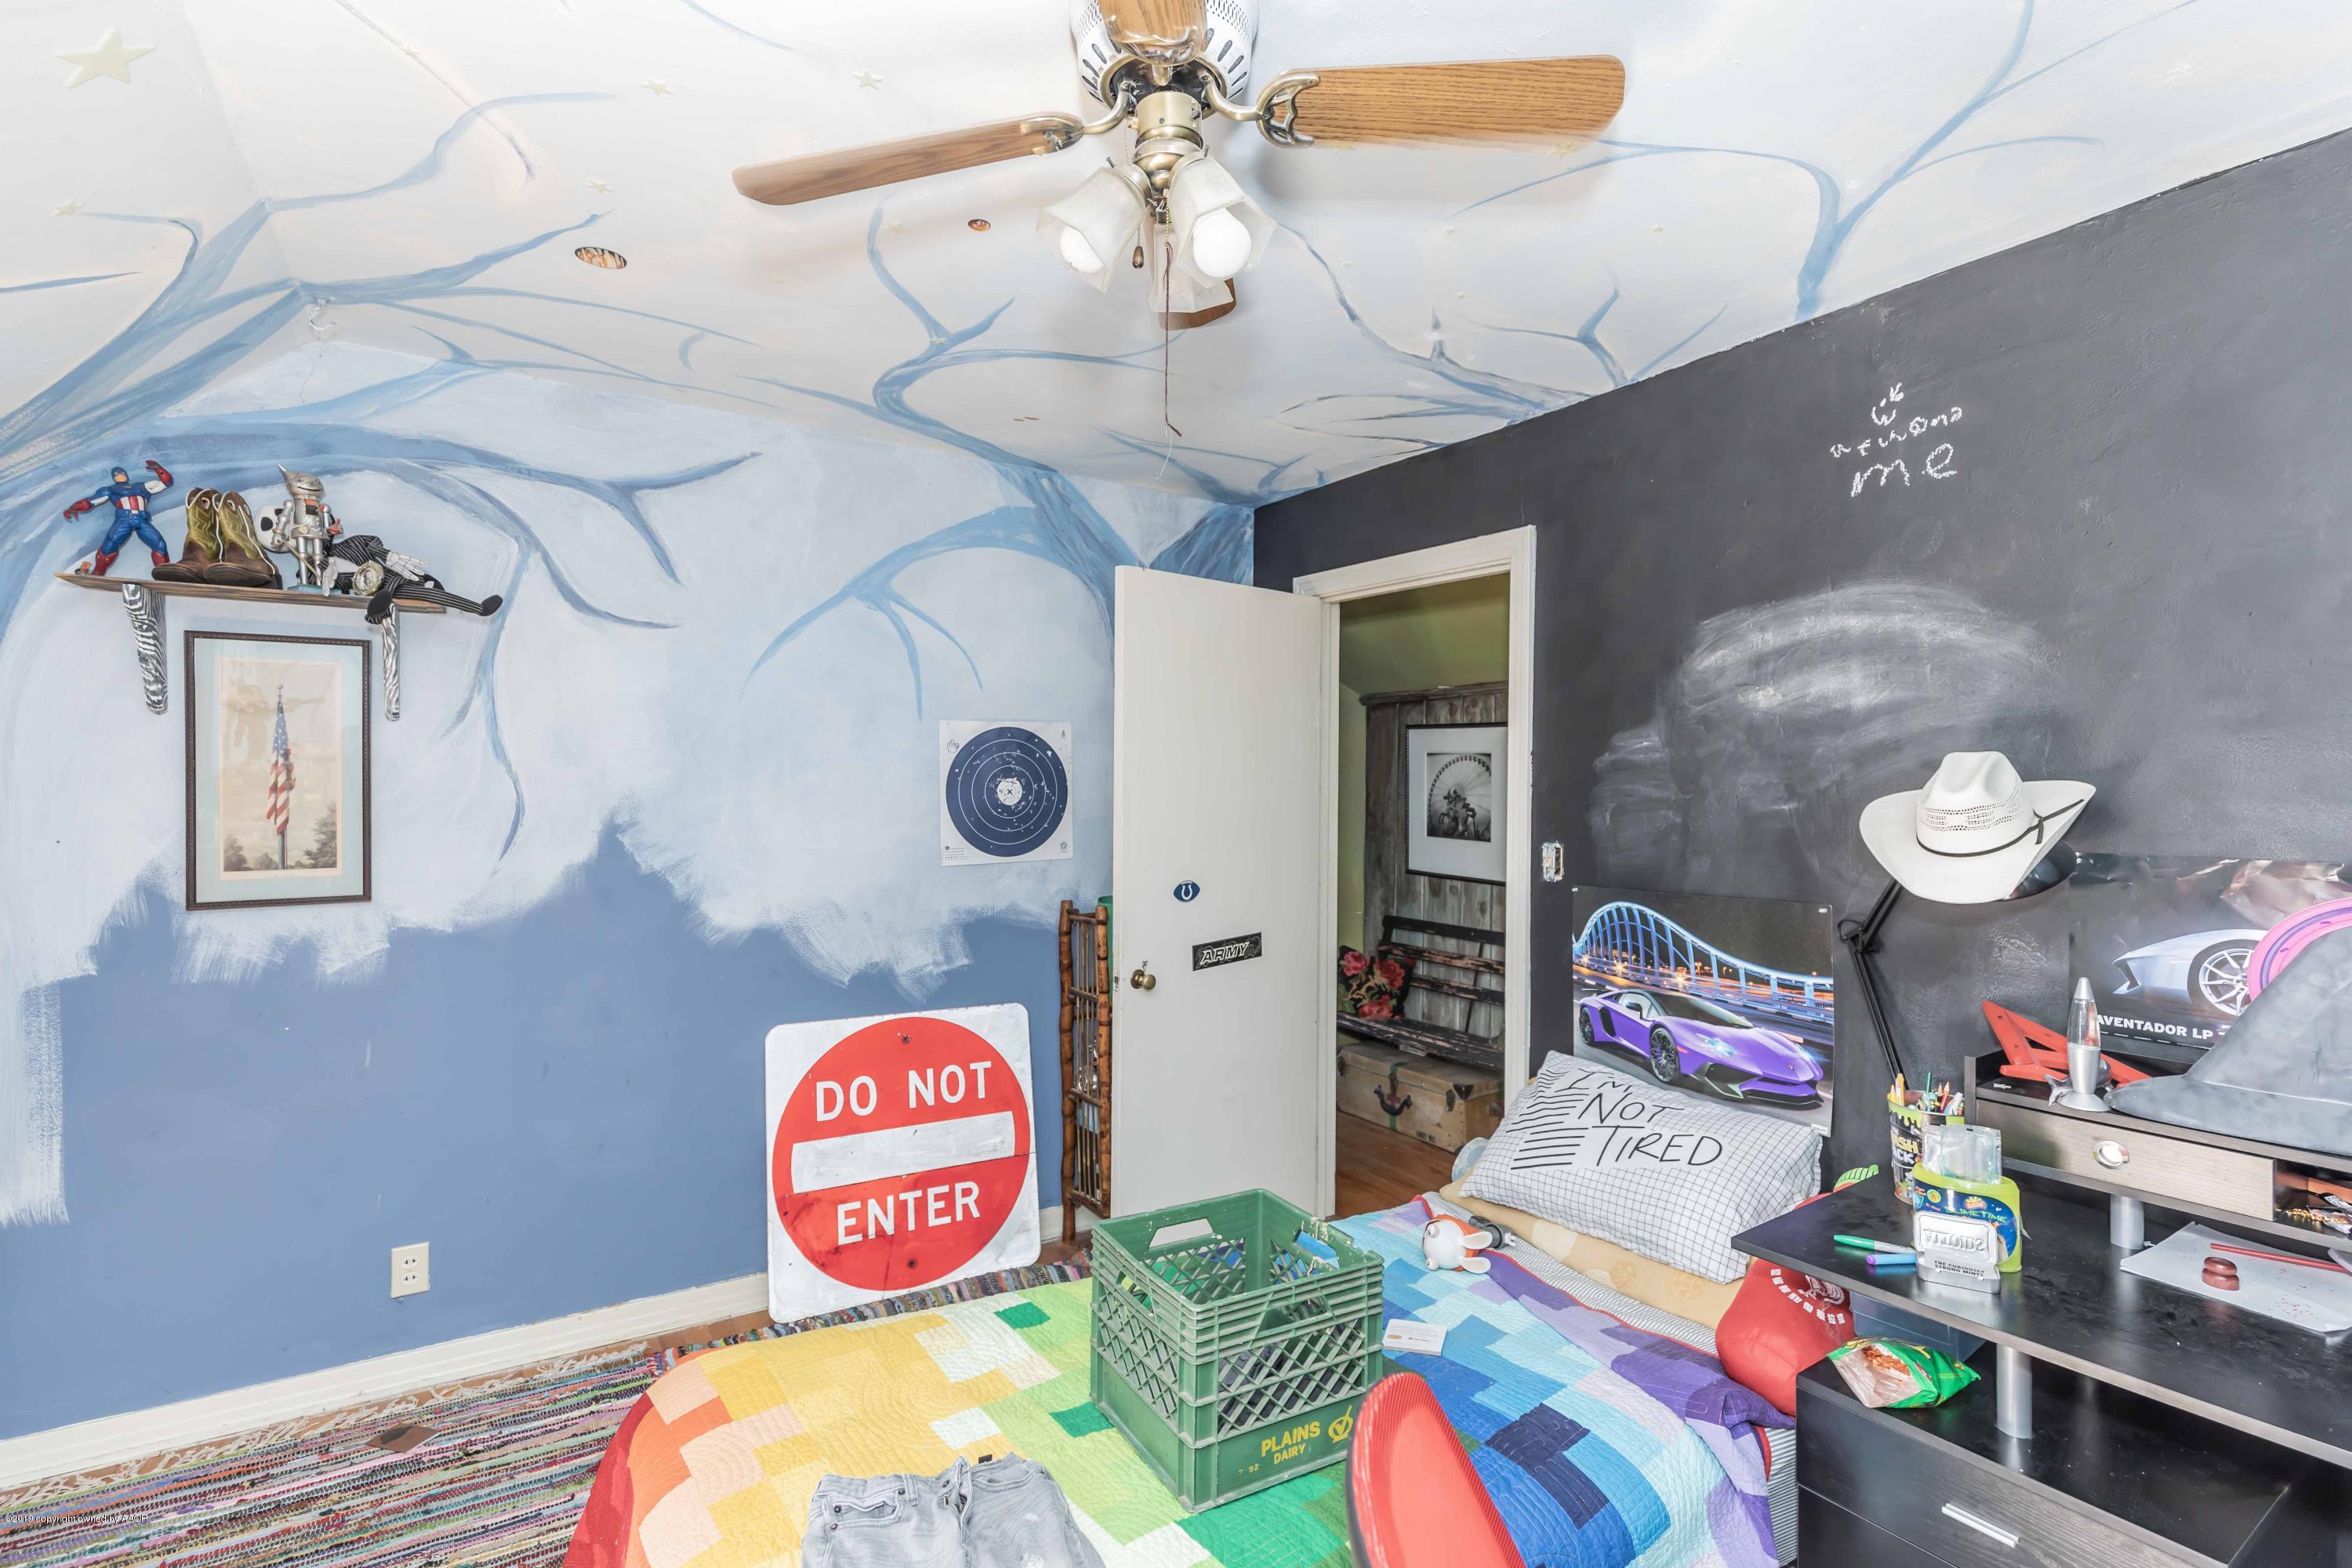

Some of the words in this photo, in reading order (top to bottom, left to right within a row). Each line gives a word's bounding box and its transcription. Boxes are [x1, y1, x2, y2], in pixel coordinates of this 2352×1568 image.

[1850, 443, 1958, 497] me
[1200, 942, 1250, 965] ARMY
[2096, 1014, 2187, 1036] AVENTADOR
[2192, 1028, 2214, 1040] LP
[815, 1075, 878, 1122] DO
[908, 1060, 992, 1109] NOT
[1577, 1092, 1686, 1124] NOT
[1592, 1125, 1723, 1167] TIRED
[837, 1181, 982, 1246] ENTER
[1934, 1264, 1961, 1273] STRONG
[1948, 1263, 1985, 1274] CURIOUSLY
[1261, 1421, 1321, 1457] PLAINS
[1273, 1443, 1306, 1465] DAIRY
